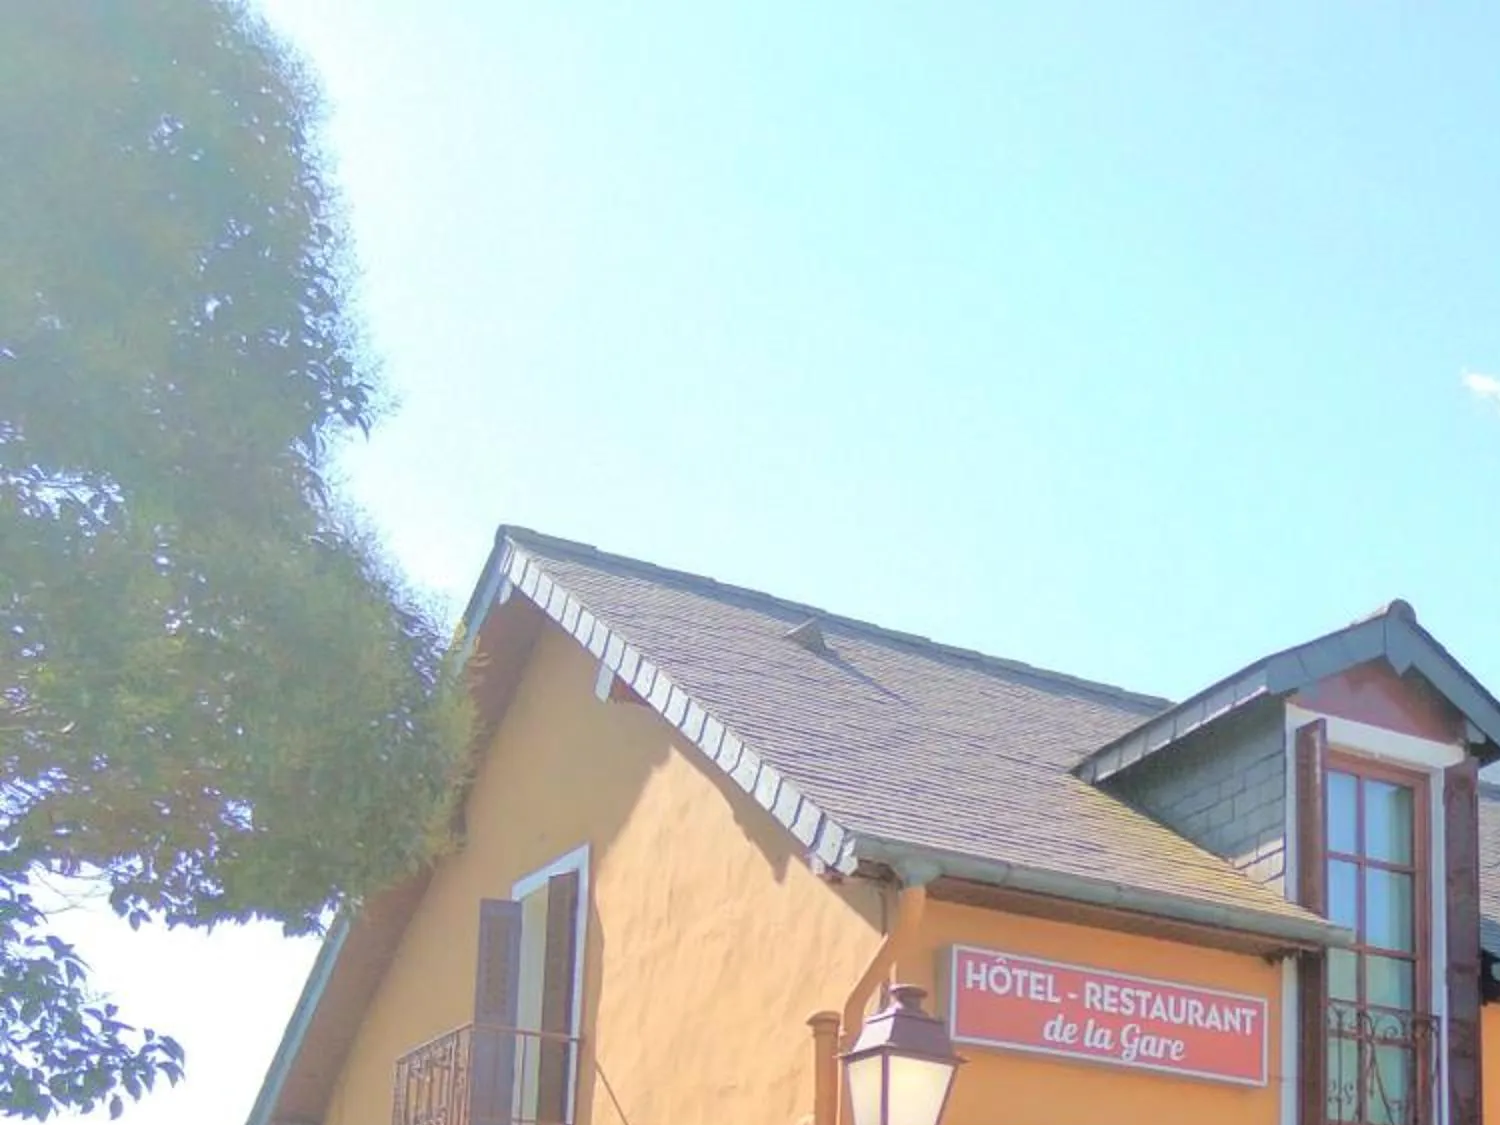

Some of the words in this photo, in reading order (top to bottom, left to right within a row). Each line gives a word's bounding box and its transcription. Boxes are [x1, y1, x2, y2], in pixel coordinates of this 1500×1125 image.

[965, 957, 1060, 1003] HÔTEL
[1084, 981, 1256, 1035] RESTAURANT
[1043, 1014, 1079, 1043] de
[1083, 1019, 1115, 1050] la
[1119, 1023, 1186, 1062] Gare
